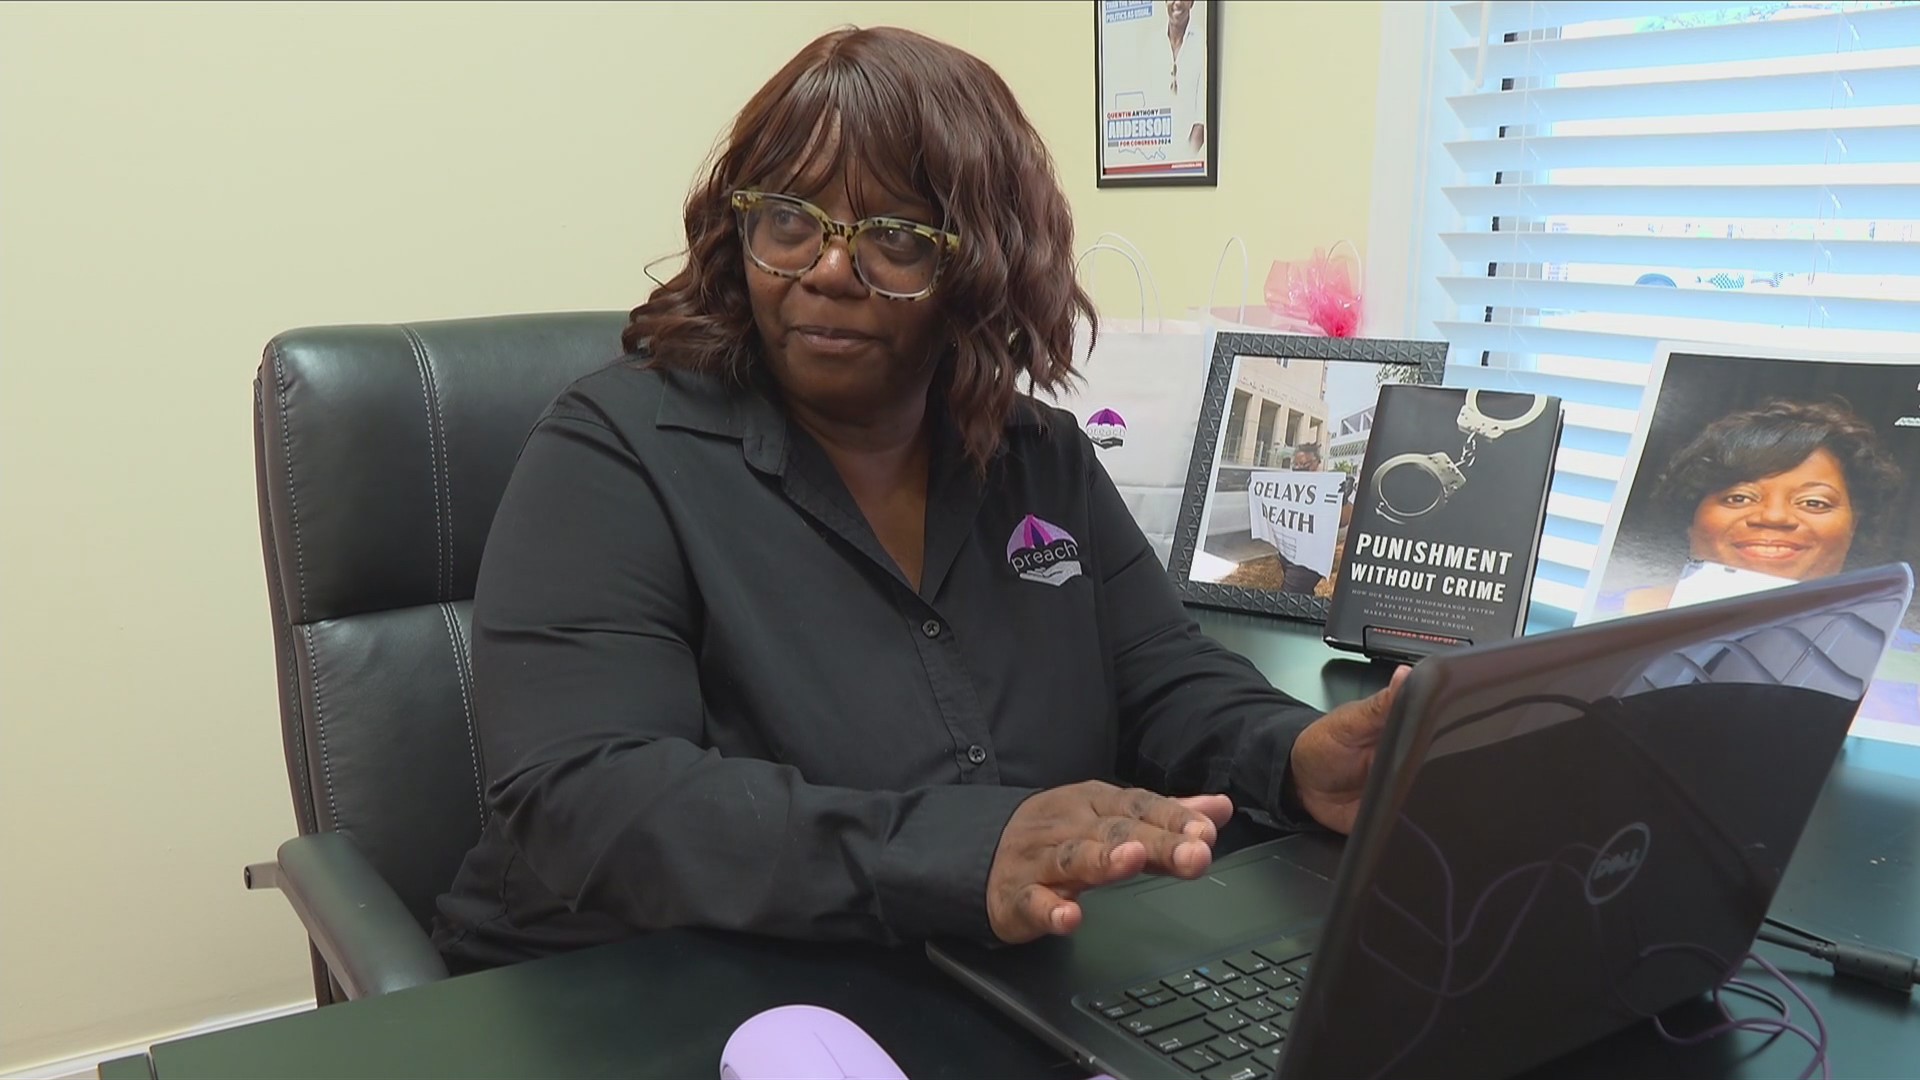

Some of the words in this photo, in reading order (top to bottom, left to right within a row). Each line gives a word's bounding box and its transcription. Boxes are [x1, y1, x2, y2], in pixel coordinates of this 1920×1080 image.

[1106, 10, 1127, 22] POLITICS
[1127, 9, 1134, 20] AS
[1107, 112, 1131, 120] QUENTIN
[1132, 109, 1159, 117] ANTHONY
[1108, 116, 1171, 139] ANDERSON
[1254, 481, 1317, 505] DELAYS
[1262, 502, 1314, 534] DEATH
[1011, 542, 1078, 572] preach
[1355, 532, 1513, 576] PUNISHMENT
[1350, 562, 1436, 592] WITHOUT
[1442, 576, 1506, 602] CRIME
[1384, 594, 1413, 602] MASSIVE
[1416, 598, 1466, 610] MISDEMEANOR
[1468, 606, 1495, 615] SYSTEM
[1414, 608, 1449, 618] INNOCENT
[1388, 613, 1418, 622] AMERICA
[1442, 622, 1474, 632] UNEQUAL
